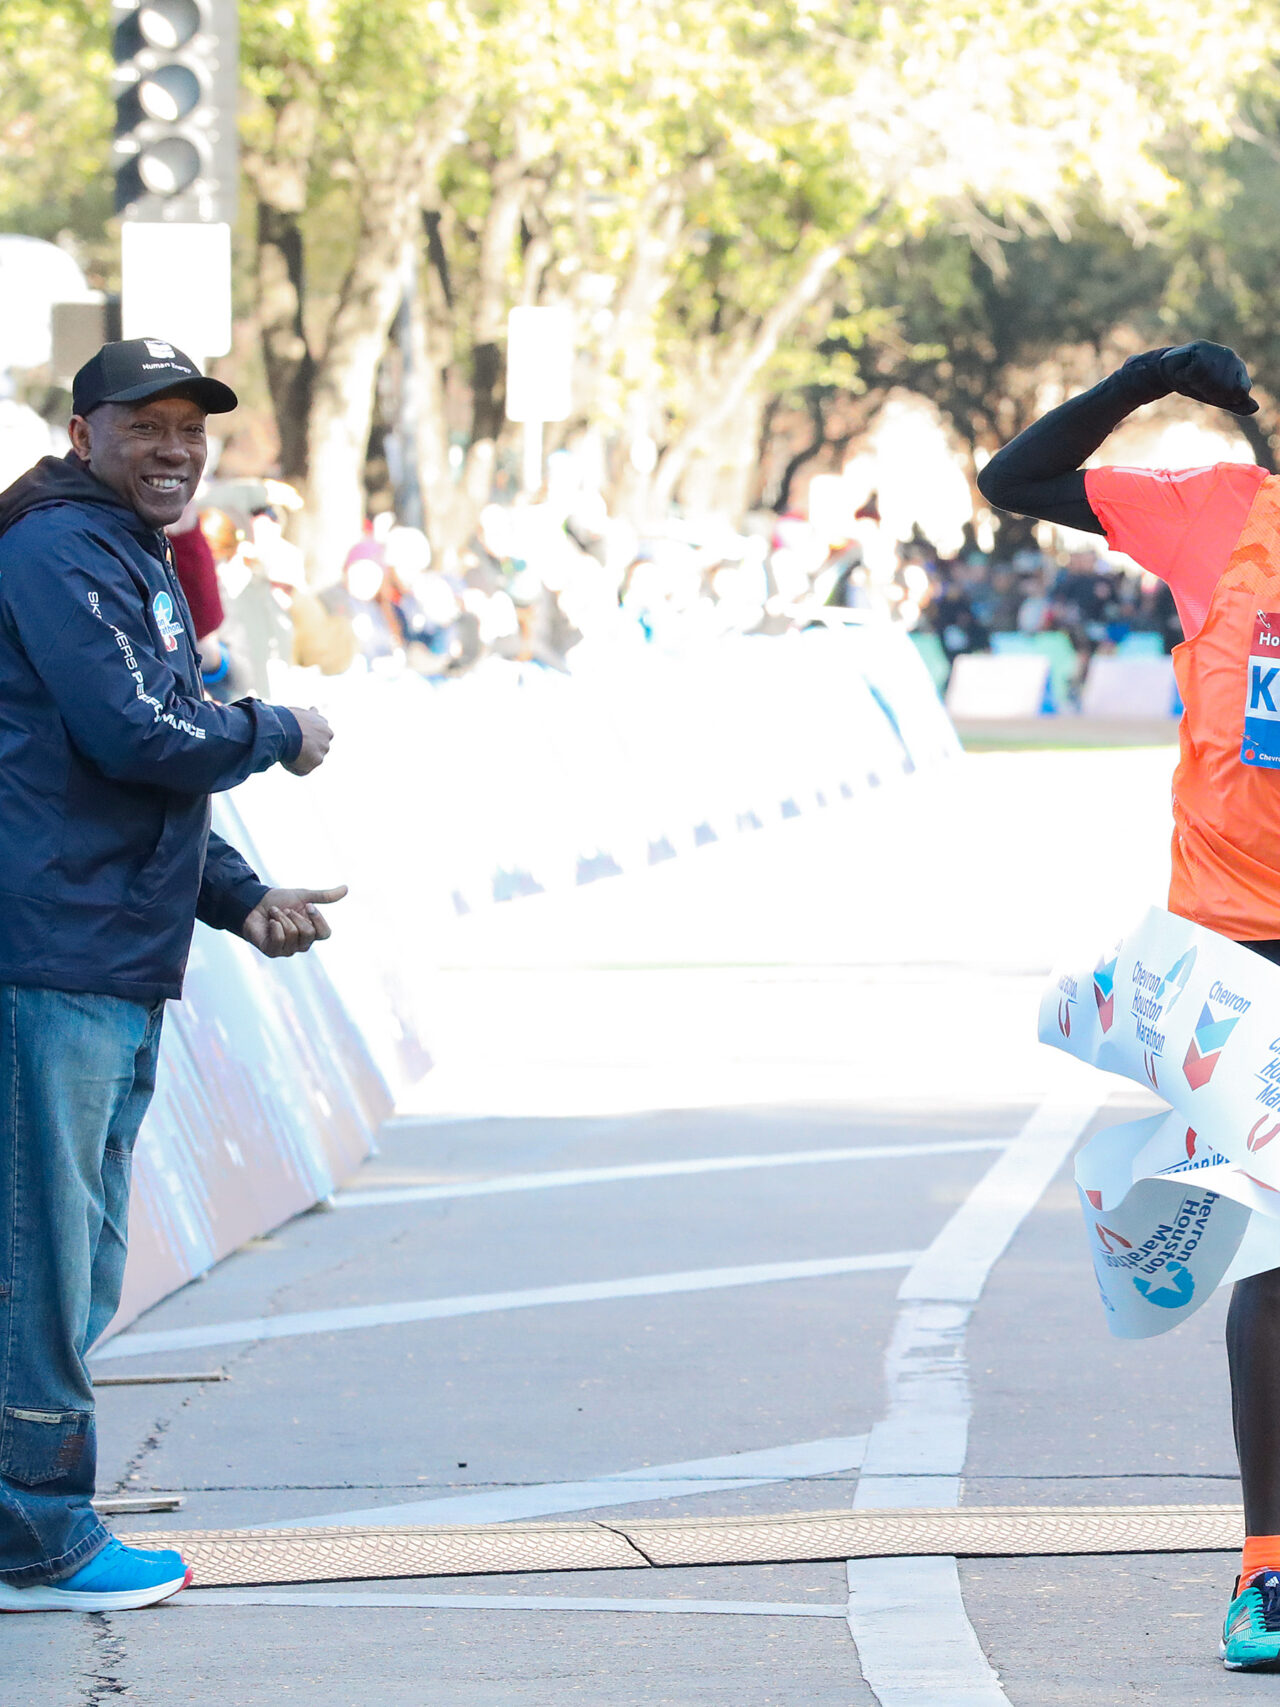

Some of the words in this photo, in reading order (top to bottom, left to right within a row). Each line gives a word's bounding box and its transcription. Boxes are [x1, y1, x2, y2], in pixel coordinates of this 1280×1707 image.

[131, 670, 206, 740] PERFMANCE
[1132, 960, 1161, 992] Chevron
[1132, 987, 1163, 1022] Houston
[1208, 980, 1252, 1014] Chevron
[1135, 1016, 1166, 1053] Marathon
[1139, 1199, 1200, 1274] Houston
[1176, 1191, 1220, 1262] hevron
